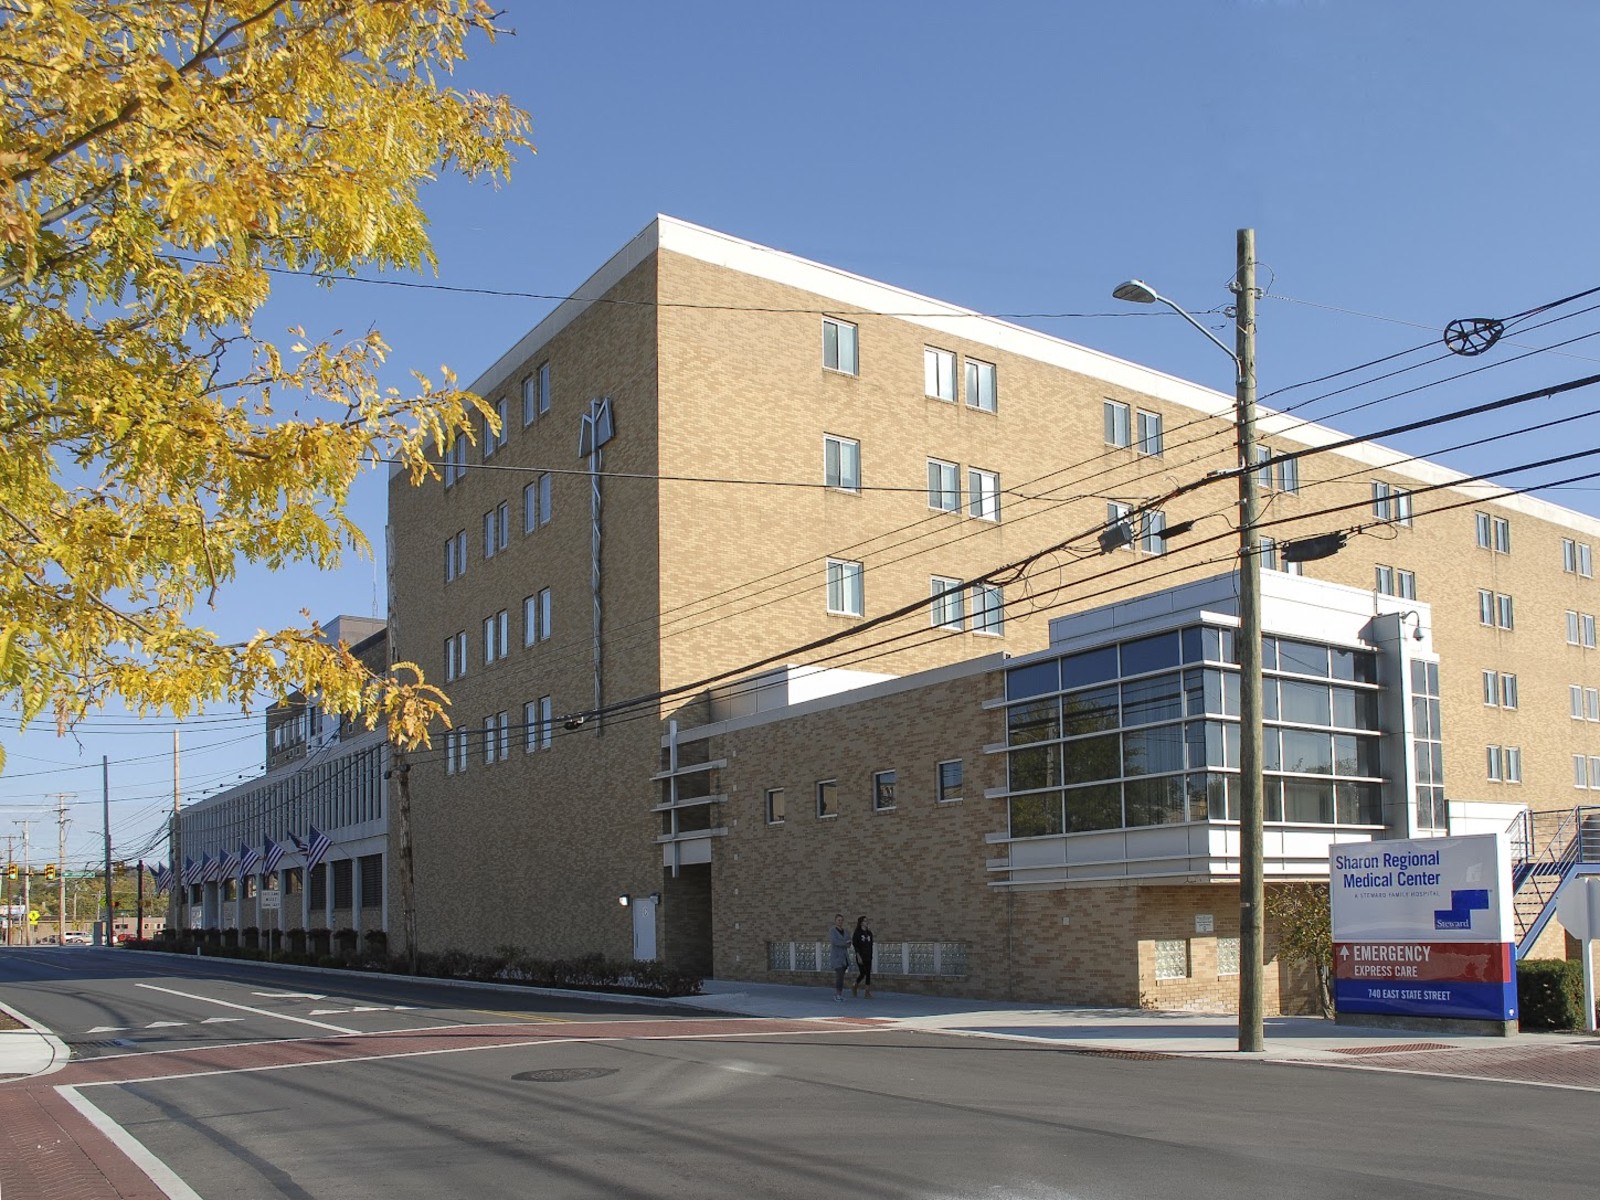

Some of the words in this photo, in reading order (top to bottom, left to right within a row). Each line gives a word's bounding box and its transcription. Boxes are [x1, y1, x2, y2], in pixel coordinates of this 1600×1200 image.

[1336, 855, 1379, 870] Sharon
[1383, 850, 1440, 871] Regional
[1343, 872, 1393, 888] Medical
[1397, 871, 1441, 886] Center
[1437, 919, 1469, 928] Steward
[1353, 945, 1431, 962] EMERGENCY
[1354, 965, 1393, 977] EXPRESS
[1394, 965, 1418, 977] CARE
[1368, 988, 1381, 998] 740
[1382, 989, 1400, 999] EAST
[1401, 990, 1422, 1000] STATE
[1423, 991, 1451, 1001] STREET
